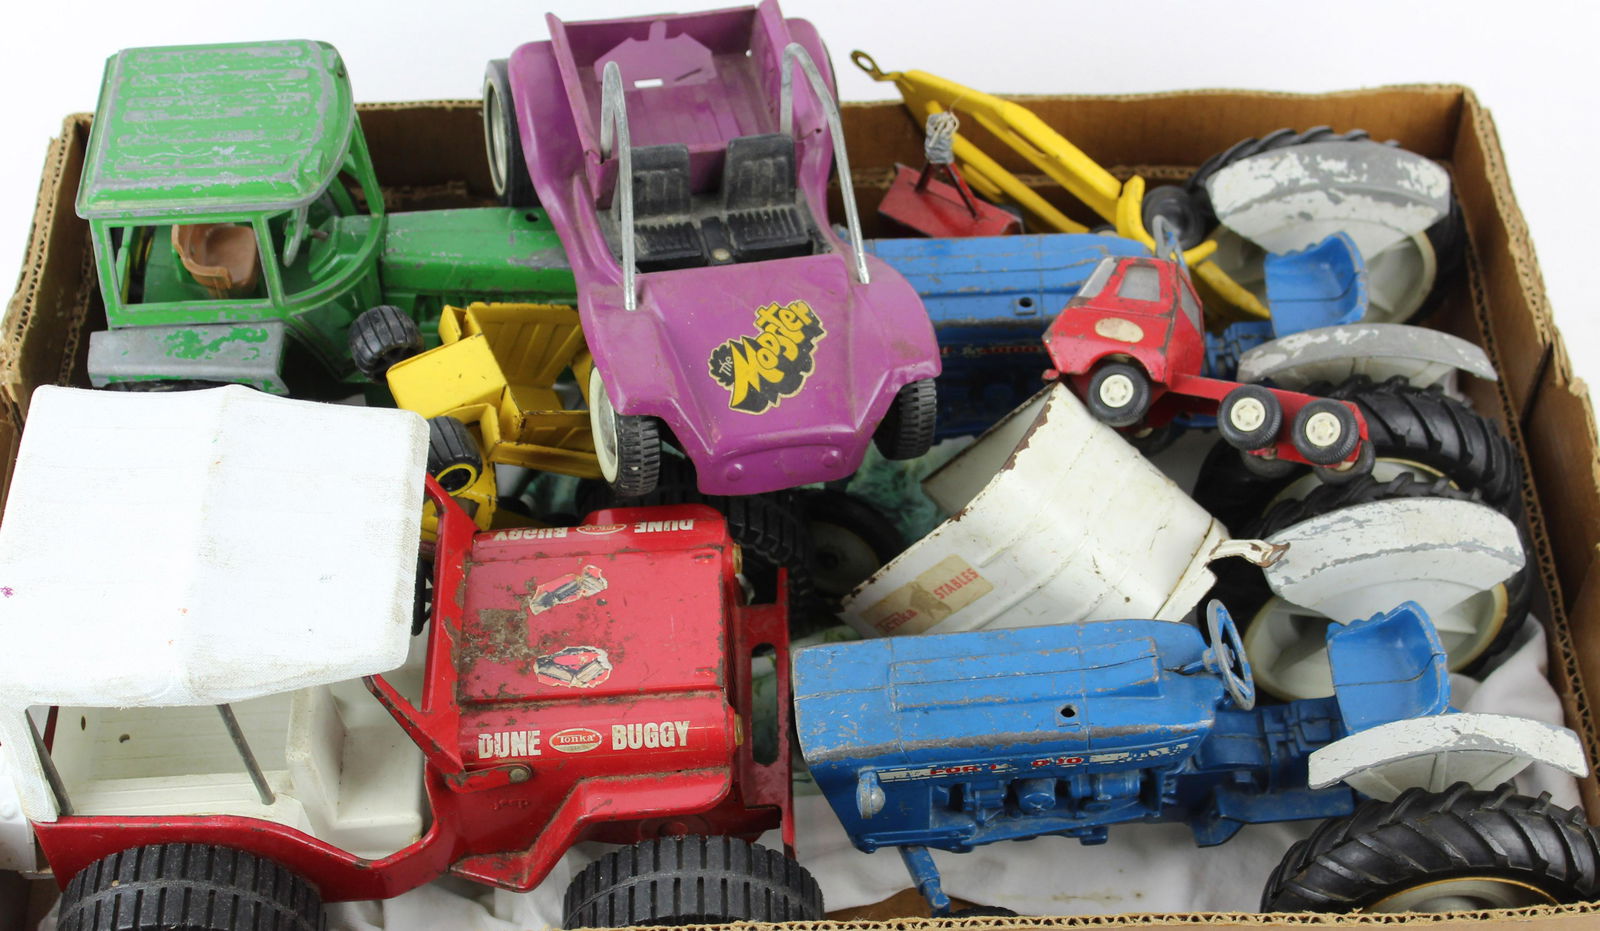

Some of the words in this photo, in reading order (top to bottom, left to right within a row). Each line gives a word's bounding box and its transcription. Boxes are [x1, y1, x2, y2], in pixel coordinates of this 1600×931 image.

[933, 568, 980, 600] STABLES
[478, 730, 542, 759] DUNE
[611, 720, 691, 750] BUGGY
